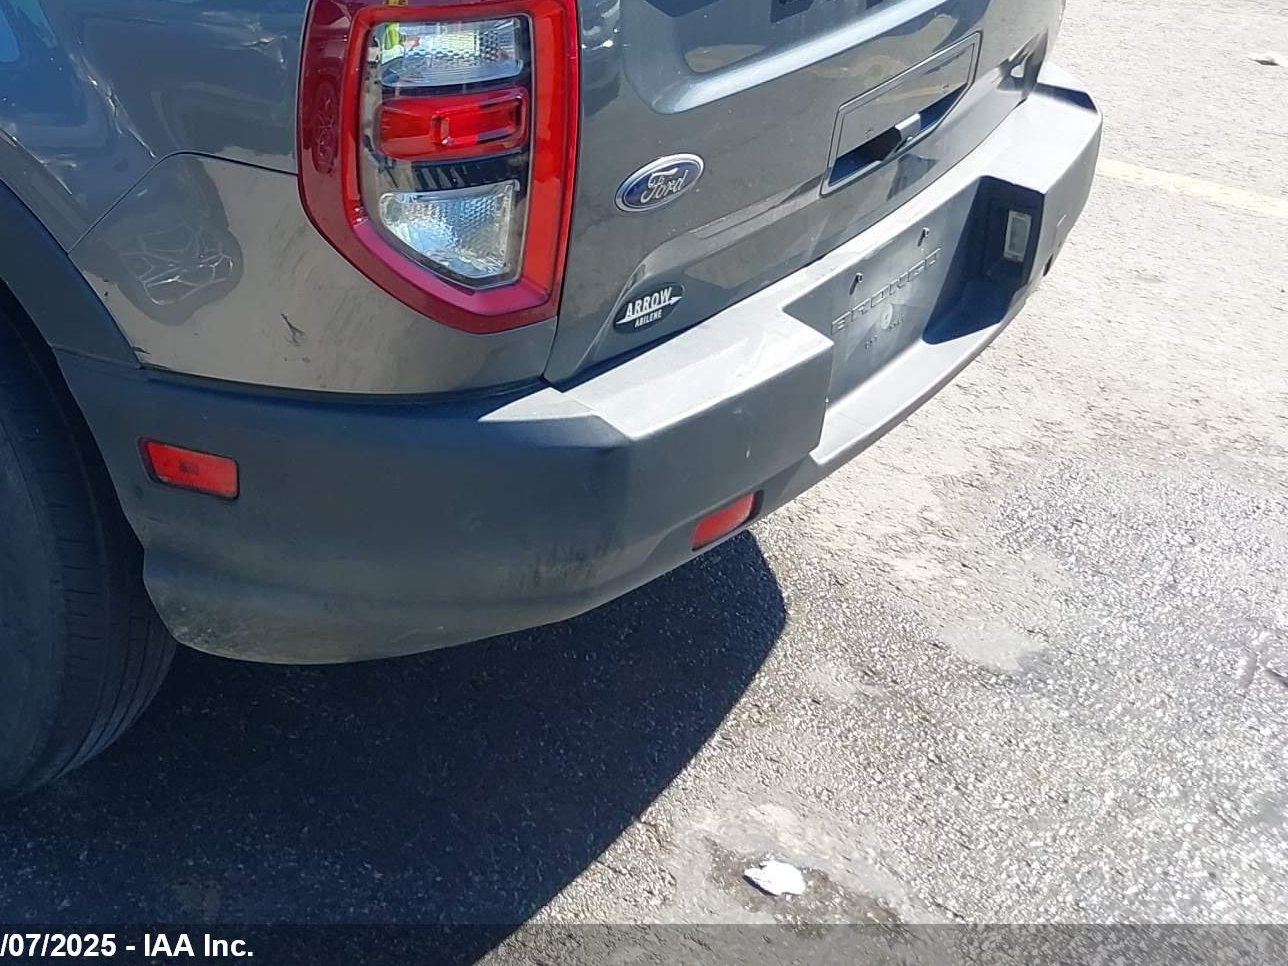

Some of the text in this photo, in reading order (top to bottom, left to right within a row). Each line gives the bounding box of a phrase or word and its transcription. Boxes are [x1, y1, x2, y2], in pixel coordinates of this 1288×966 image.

[640, 167, 689, 204] Ford
[624, 286, 673, 320] ARROW
[830, 247, 942, 336] BRONCO
